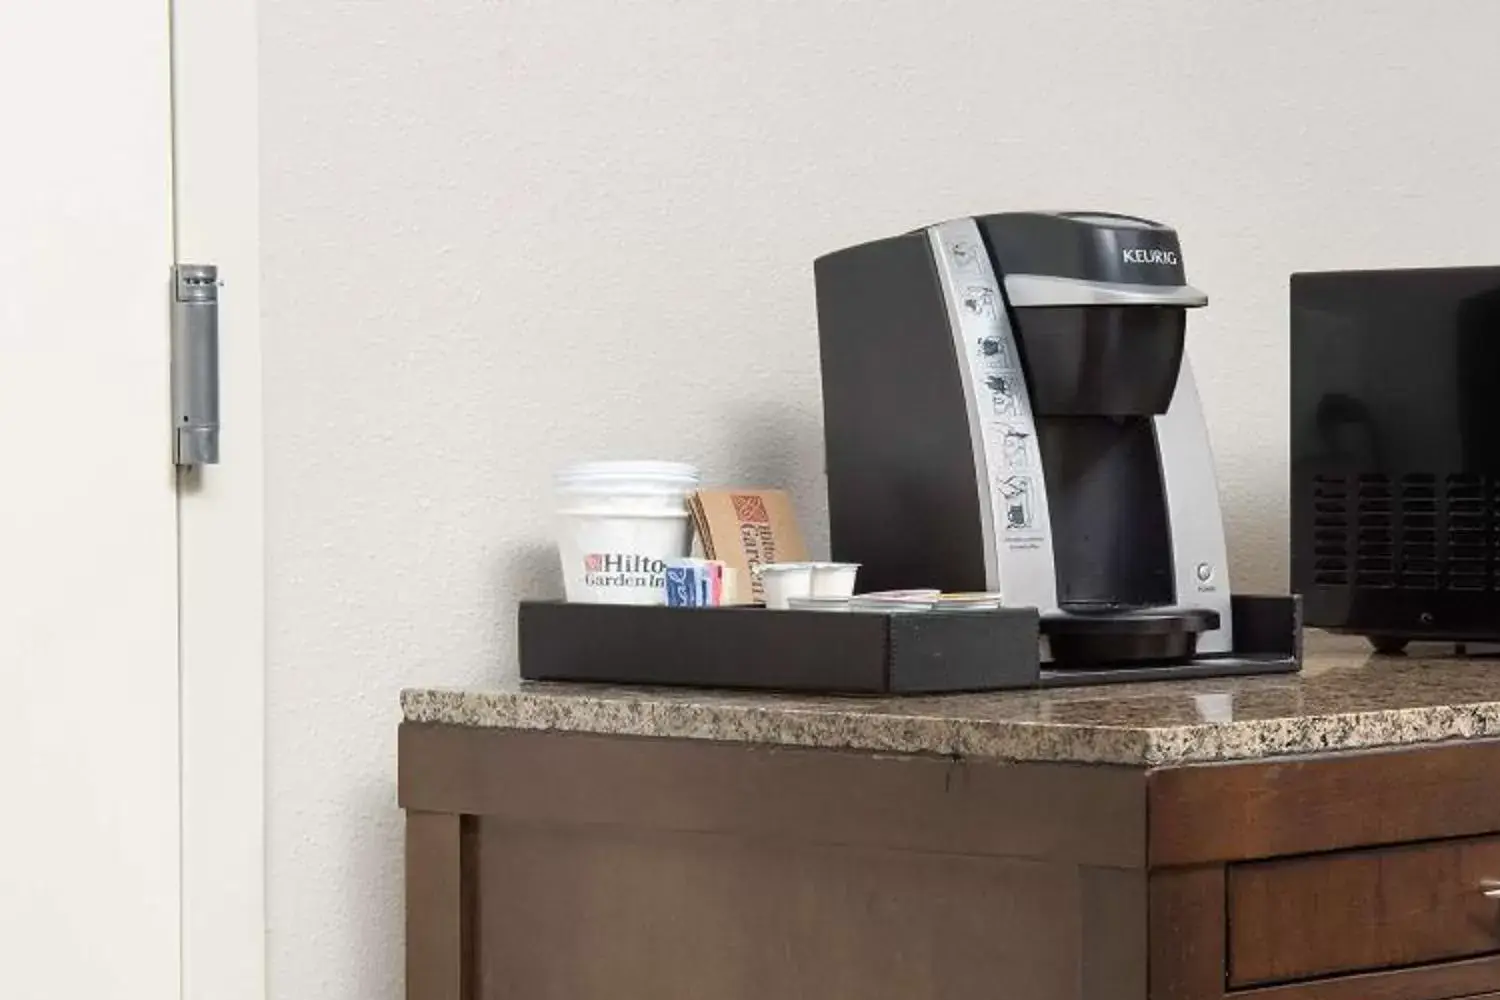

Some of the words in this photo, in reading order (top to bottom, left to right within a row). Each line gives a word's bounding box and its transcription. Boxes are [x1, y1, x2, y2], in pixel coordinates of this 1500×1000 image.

[1122, 249, 1177, 265] KEURIG
[757, 525, 777, 565] Hilto
[603, 553, 667, 573] Hilto
[585, 573, 646, 588] Garden
[649, 574, 665, 588] In
